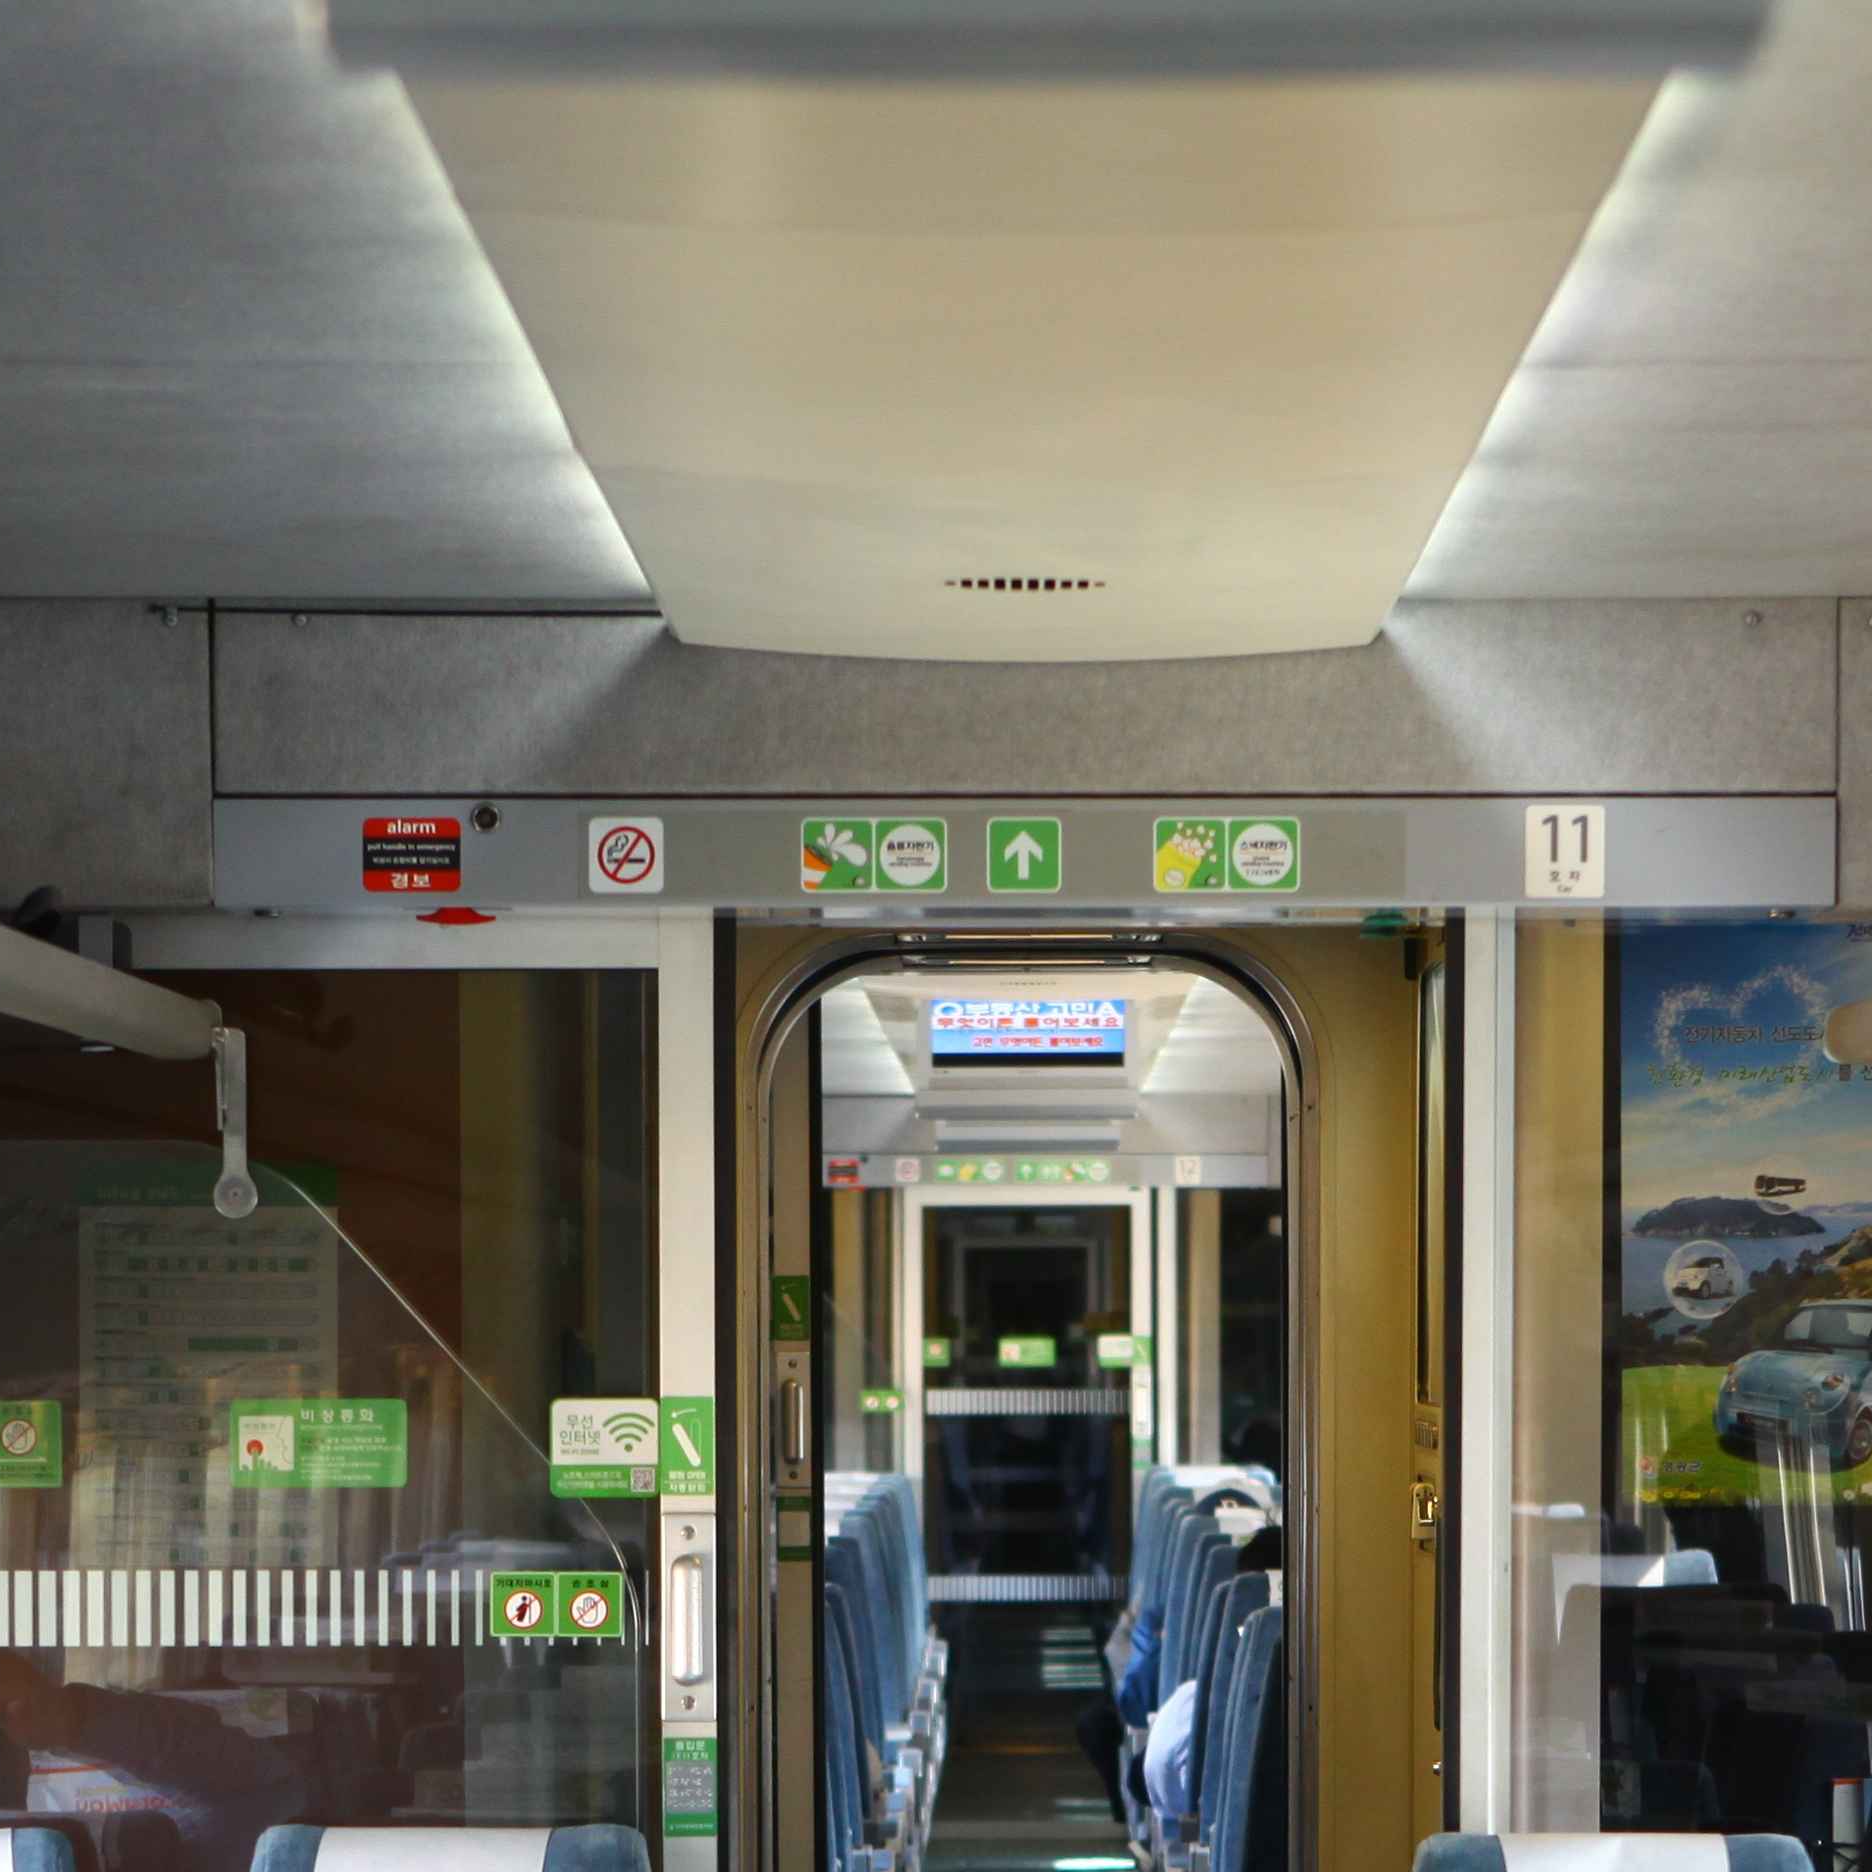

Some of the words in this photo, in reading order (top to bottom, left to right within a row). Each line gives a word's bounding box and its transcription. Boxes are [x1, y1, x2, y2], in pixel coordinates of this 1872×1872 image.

[387, 819, 437, 835] alarm
[1542, 815, 1588, 863] 11
[1684, 1024, 1763, 1043] 전기자동차
[1771, 1024, 1825, 1042] 선도도
[567, 1415, 594, 1430] 무선
[559, 1430, 601, 1446] 인터넷
